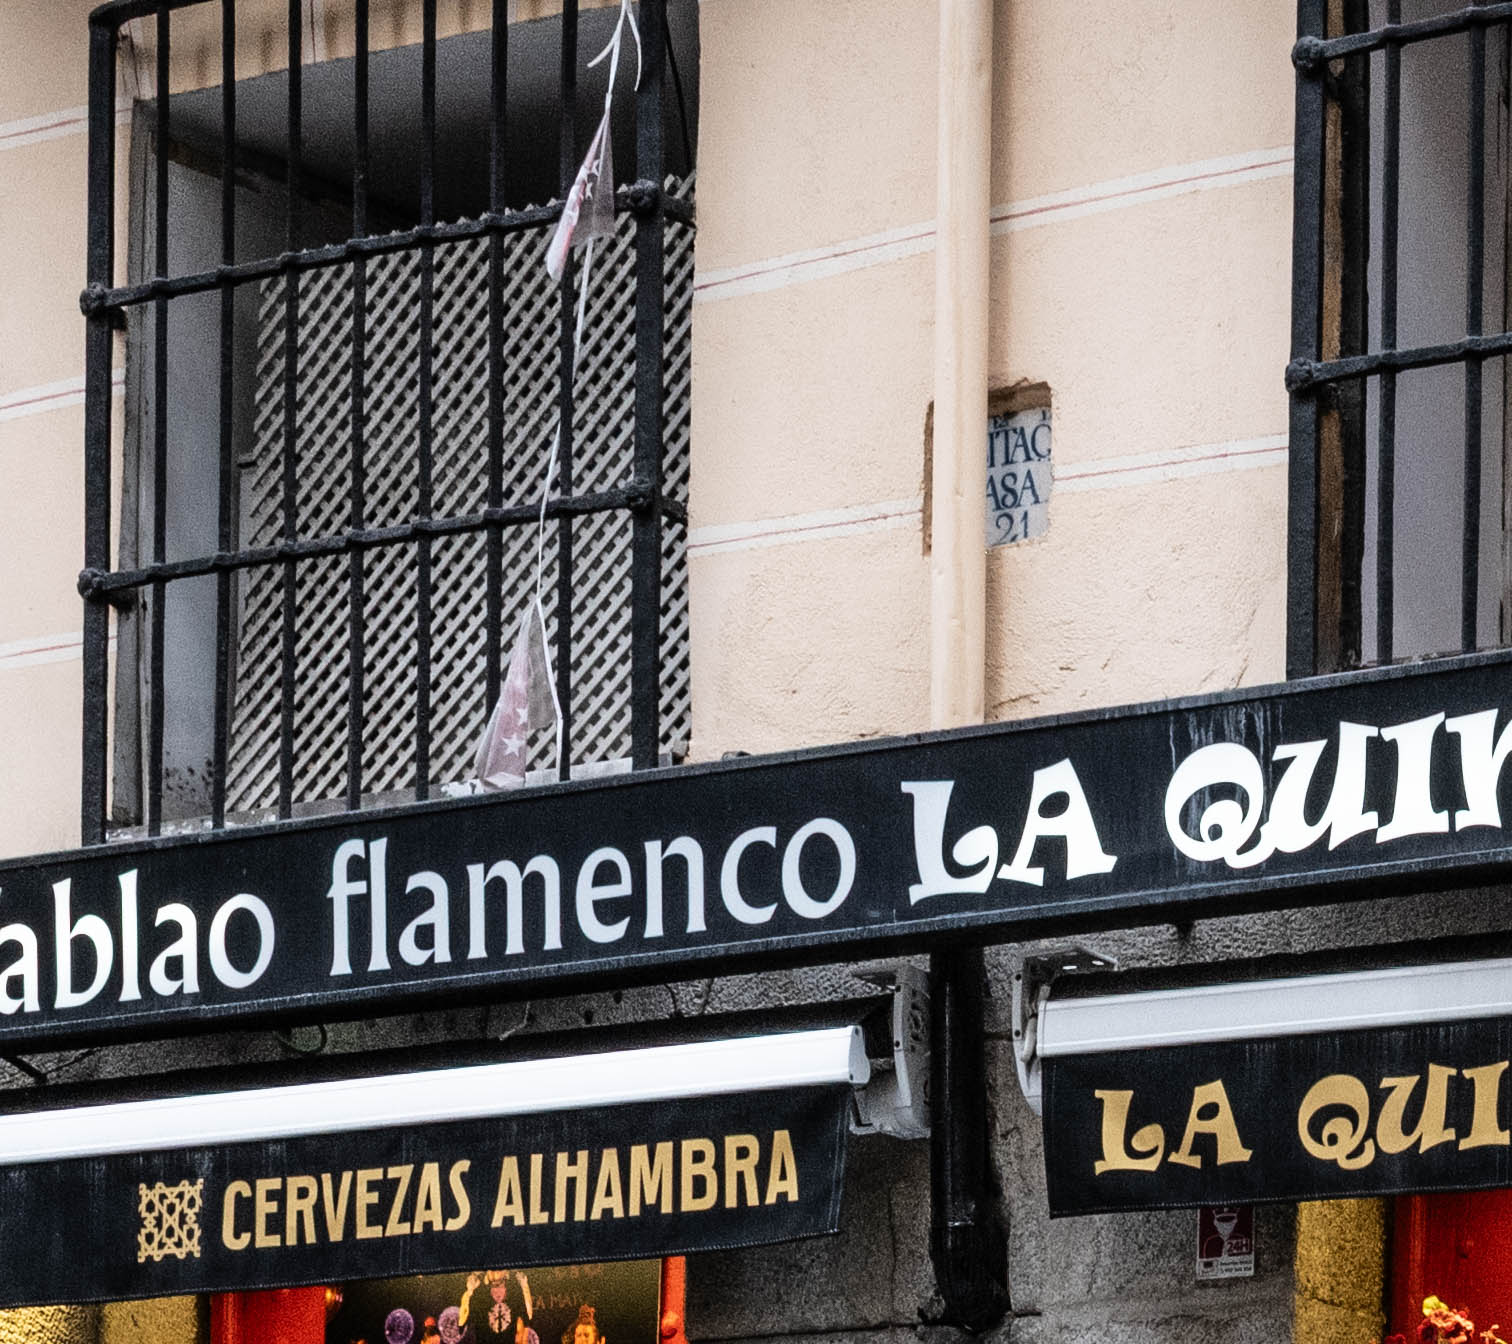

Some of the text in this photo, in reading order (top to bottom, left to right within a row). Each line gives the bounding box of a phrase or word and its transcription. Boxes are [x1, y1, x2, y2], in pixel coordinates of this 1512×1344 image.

[326, 816, 858, 977] flamenco
[901, 757, 1120, 907] LA
[1093, 1078, 1253, 1176] LA
[221, 1129, 800, 1252] CERVEZAS ALHAMBRA
